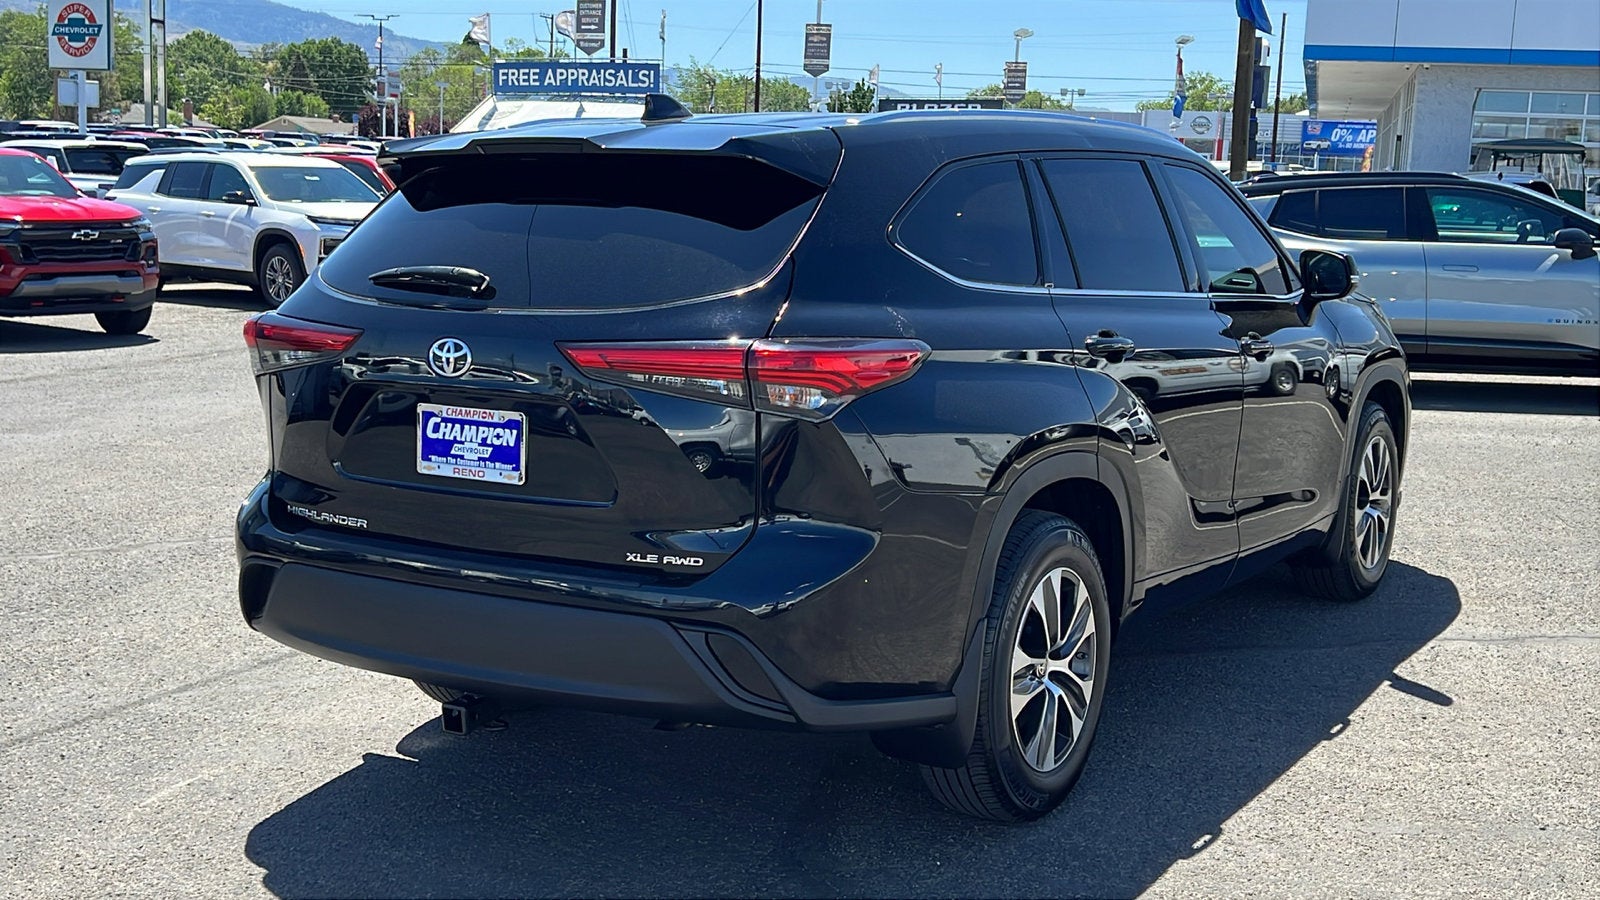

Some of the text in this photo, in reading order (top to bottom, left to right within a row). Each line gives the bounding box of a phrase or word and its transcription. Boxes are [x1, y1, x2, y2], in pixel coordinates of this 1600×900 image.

[61, 4, 91, 18] SUPER
[54, 26, 99, 34] CHEVROLET
[59, 39, 95, 57] SERVICE
[498, 68, 655, 88] FREE APPRAISALS!
[1331, 128, 1377, 143] 0% AP
[445, 407, 495, 420] CHAMPION
[426, 416, 518, 447] CHAMPION
[453, 445, 489, 455] CHEVROLET
[452, 467, 486, 478] RENO
[287, 504, 368, 529] HIGHLANDER
[626, 552, 704, 566] XLE AWD
